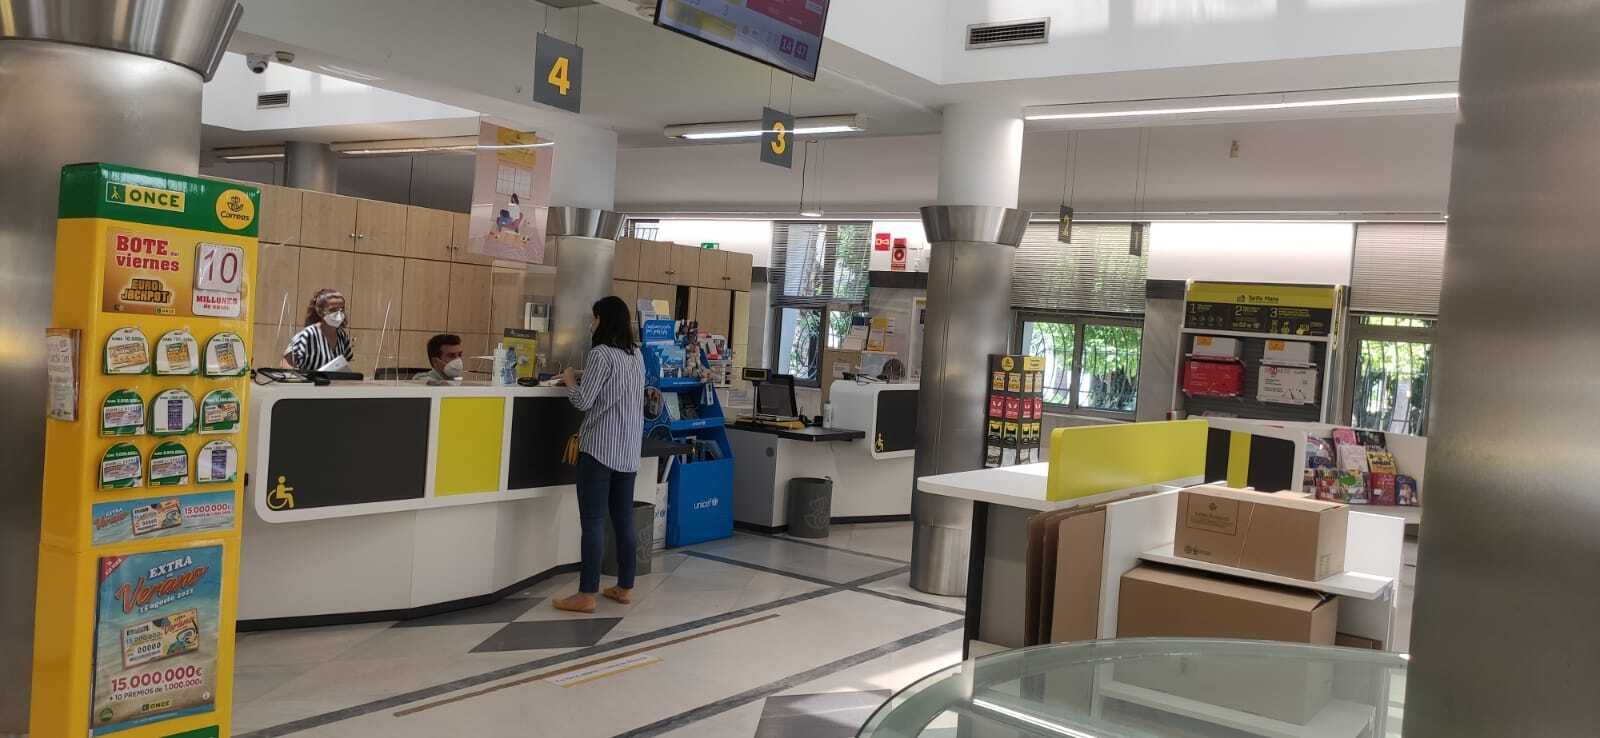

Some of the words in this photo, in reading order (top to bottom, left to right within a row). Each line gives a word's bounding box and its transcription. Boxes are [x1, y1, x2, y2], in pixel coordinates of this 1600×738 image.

[548, 57, 570, 96] 4
[770, 122, 786, 155] 3
[129, 189, 180, 208] ONCE
[220, 210, 250, 221] Correos
[116, 235, 168, 256] BOTE
[116, 253, 180, 272] viernes
[204, 249, 238, 284] 10
[131, 278, 160, 291] EURO
[121, 288, 170, 304] JACKPOT
[196, 295, 238, 305] MILLONES
[1190, 303, 1197, 314] 1
[1235, 305, 1243, 316] 2
[1269, 308, 1279, 318] 3
[693, 498, 711, 509] unicef
[149, 555, 192, 579] EXTRA
[115, 566, 208, 614] Verano
[111, 665, 202, 692] 15.000.000€
[124, 687, 154, 700] PREMIOS
